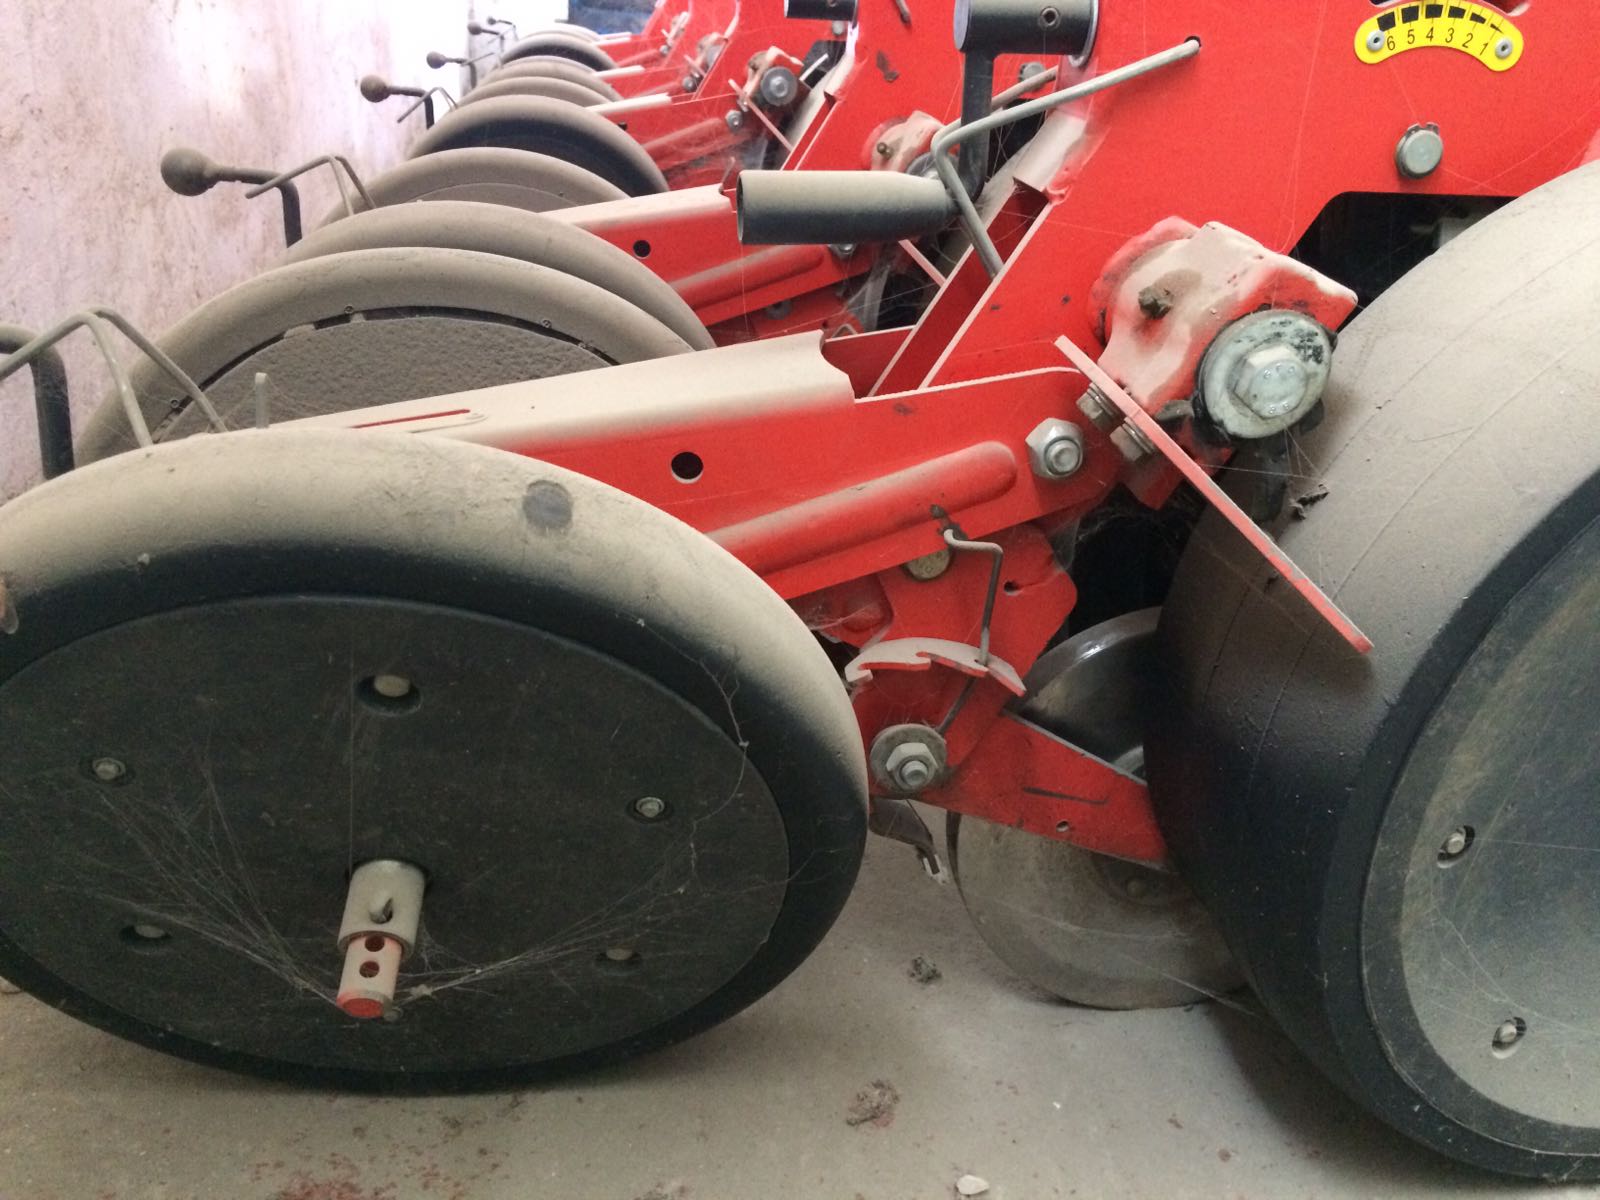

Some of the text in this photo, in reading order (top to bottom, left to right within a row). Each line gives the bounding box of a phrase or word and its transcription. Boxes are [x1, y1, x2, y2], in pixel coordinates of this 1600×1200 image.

[1386, 26, 1489, 56] 6 5 4 3 2 1
